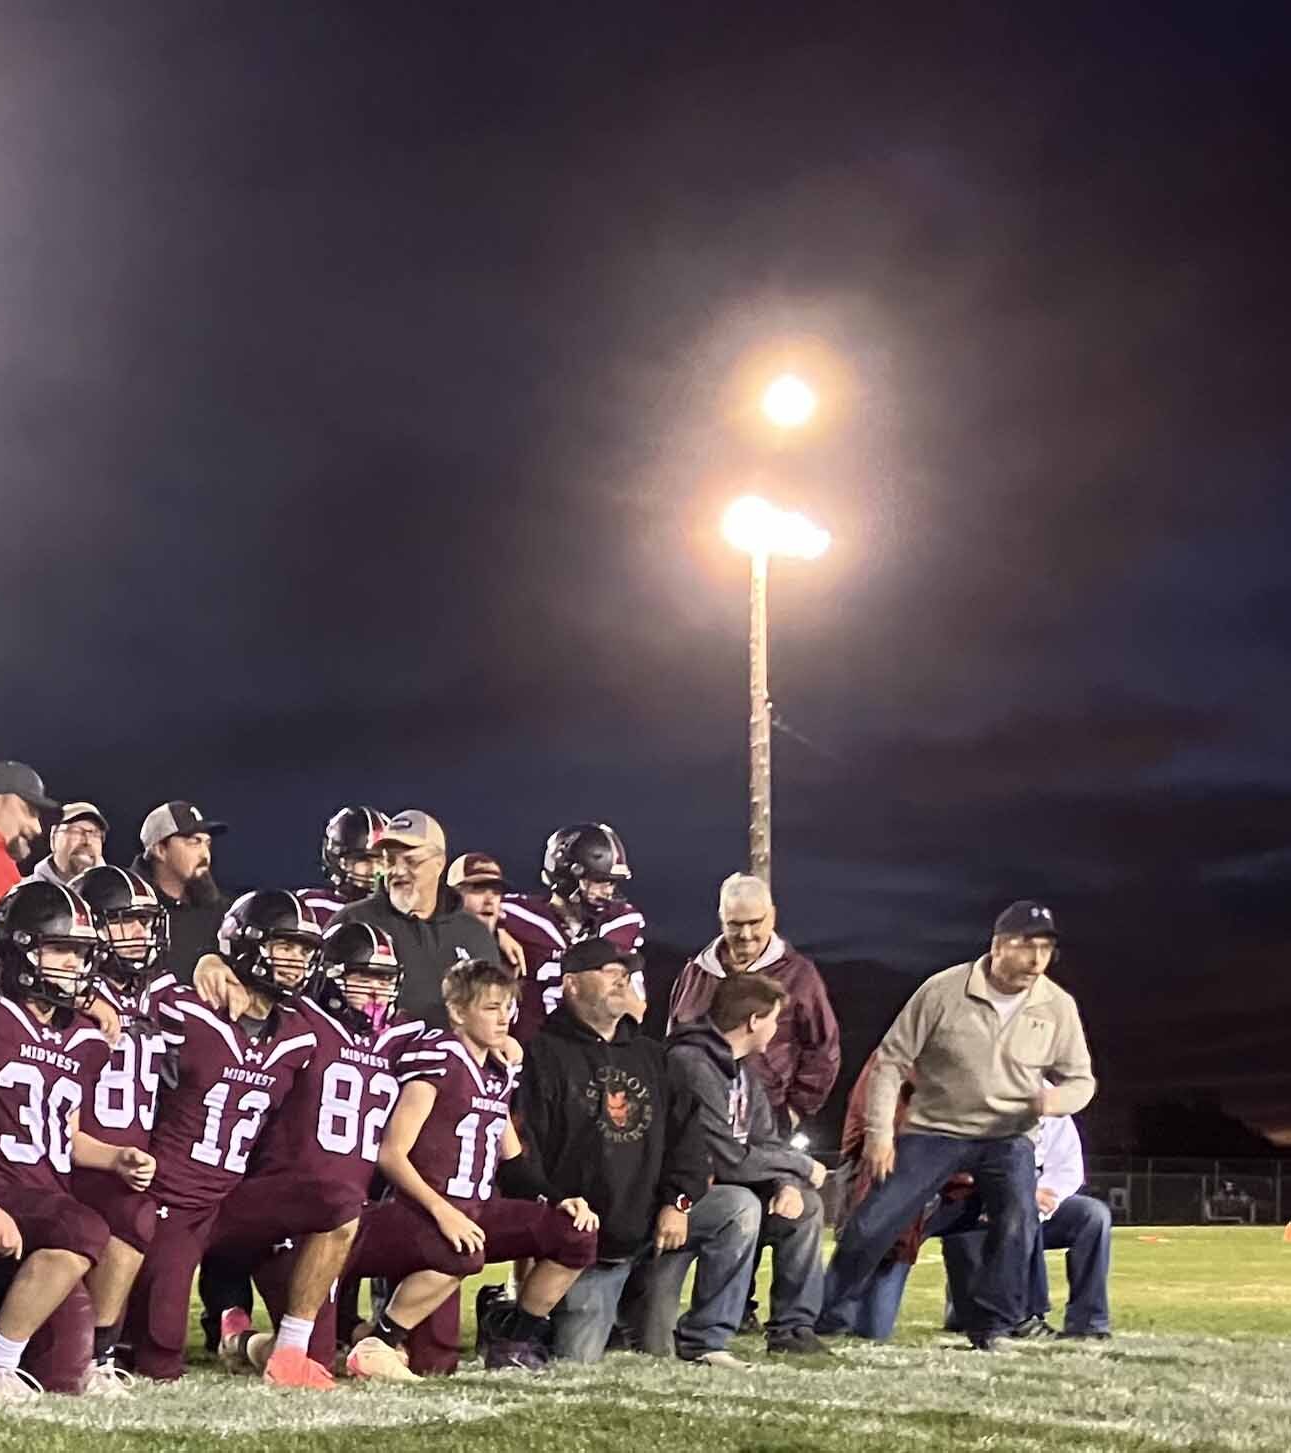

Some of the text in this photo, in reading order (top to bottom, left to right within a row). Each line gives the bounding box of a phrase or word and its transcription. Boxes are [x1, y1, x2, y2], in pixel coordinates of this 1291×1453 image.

[20, 1043, 81, 1075] MIDWEST
[94, 1032, 166, 1131] 85
[222, 1066, 277, 1088] MIDWEST
[340, 1047, 390, 1070] MIDWEST
[190, 1082, 271, 1174] 12
[316, 1062, 400, 1163] 82
